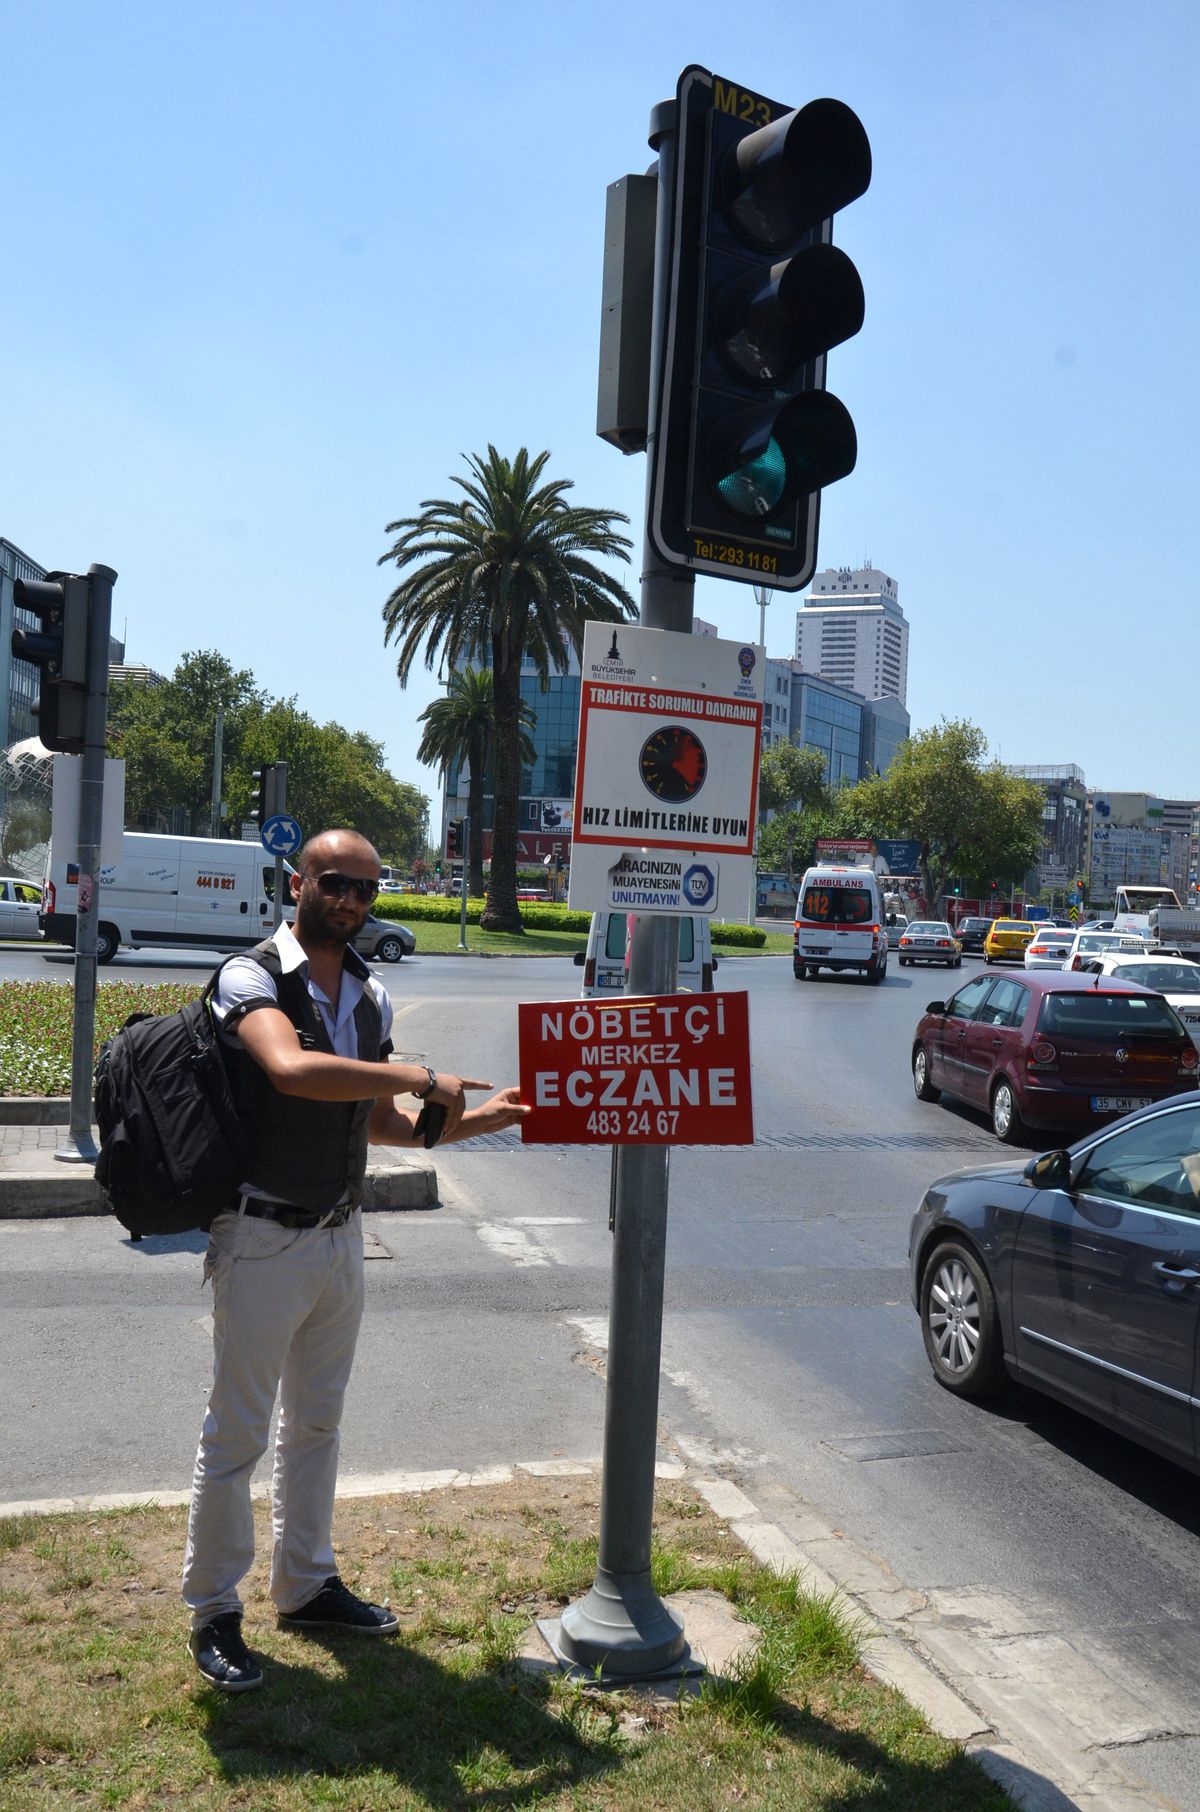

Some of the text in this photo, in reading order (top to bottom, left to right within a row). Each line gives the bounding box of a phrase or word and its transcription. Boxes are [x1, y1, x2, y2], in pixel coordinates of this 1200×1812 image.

[714, 80, 773, 127] M23
[589, 687, 757, 722] TRAFİKTE SORUMLU DAVRANIN
[582, 806, 748, 837] HIZ LİMİTLERİNE UYUN
[614, 859, 682, 875] ARACINIZIN
[196, 876, 212, 889] 444
[213, 877, 219, 889] 0
[812, 878, 864, 889] AMBULANS
[612, 890, 680, 906] UNUTMAYIN!
[806, 895, 829, 915] 112
[541, 998, 725, 1044] NÖBETÇİ
[581, 1043, 681, 1066] MERKEZ
[535, 1068, 736, 1107] ECZANE
[1098, 1098, 1109, 1109] 35
[587, 1110, 680, 1135] 483 24 67
